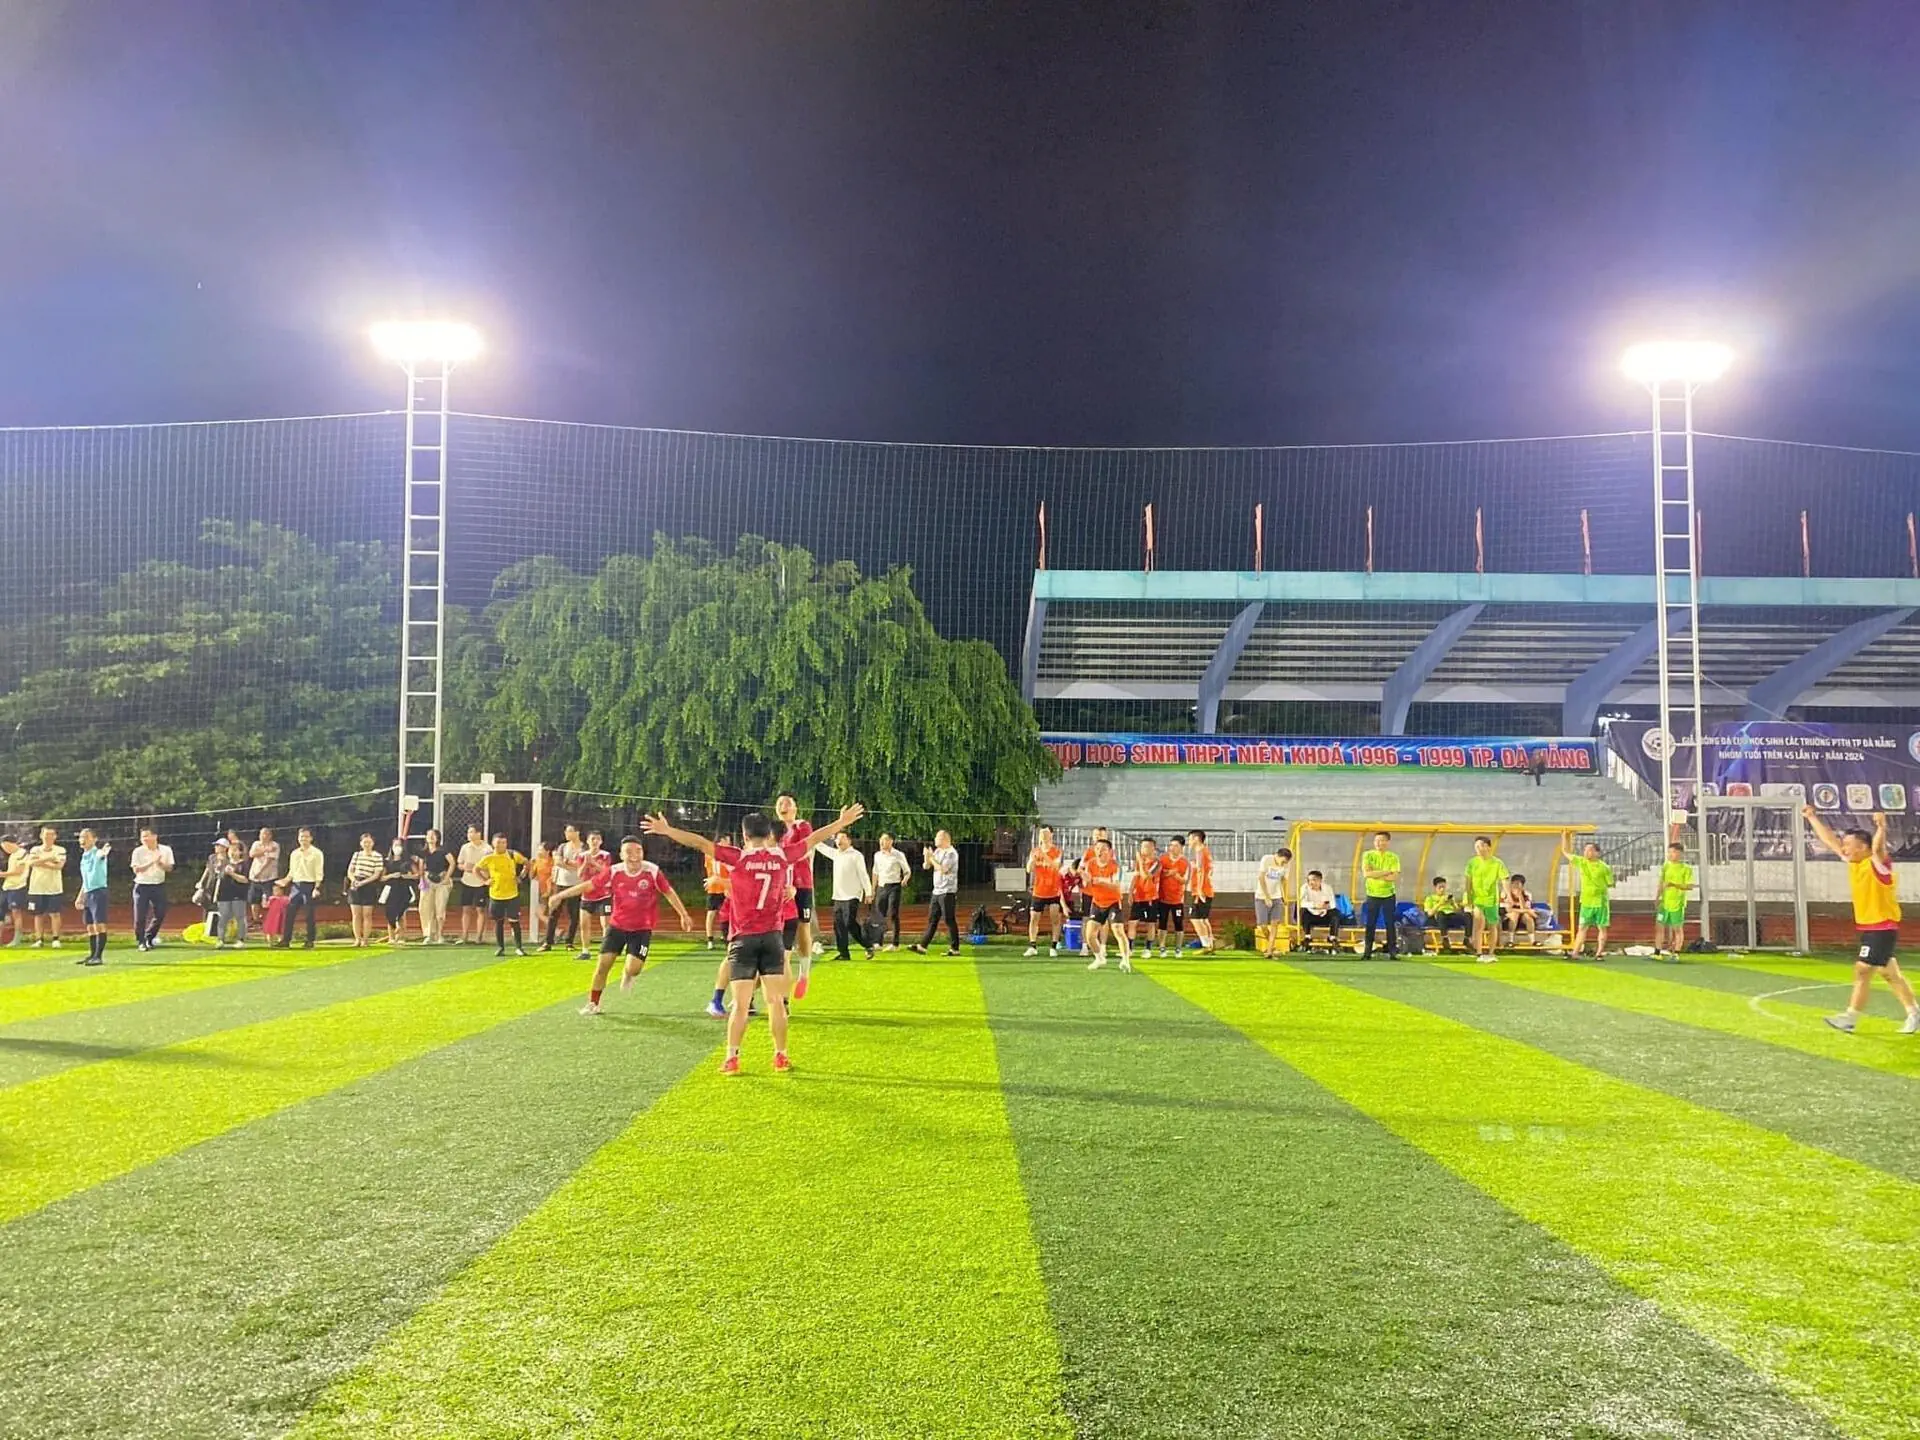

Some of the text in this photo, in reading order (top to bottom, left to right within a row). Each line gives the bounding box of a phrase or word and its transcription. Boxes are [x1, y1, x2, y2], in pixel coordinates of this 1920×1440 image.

[1085, 743, 1126, 768] HỌC
[1131, 743, 1179, 765] SINH
[1183, 744, 1232, 765] THPT
[1237, 741, 1286, 766] NIÊN
[1290, 741, 1345, 767] KHOÁ
[1350, 745, 1399, 767] 1996
[1416, 746, 1465, 768] 1999
[1469, 746, 1498, 768] TP.
[1501, 743, 1529, 768] ĐÀ
[1852, 738, 1861, 747] TP
[755, 872, 771, 910] 7
